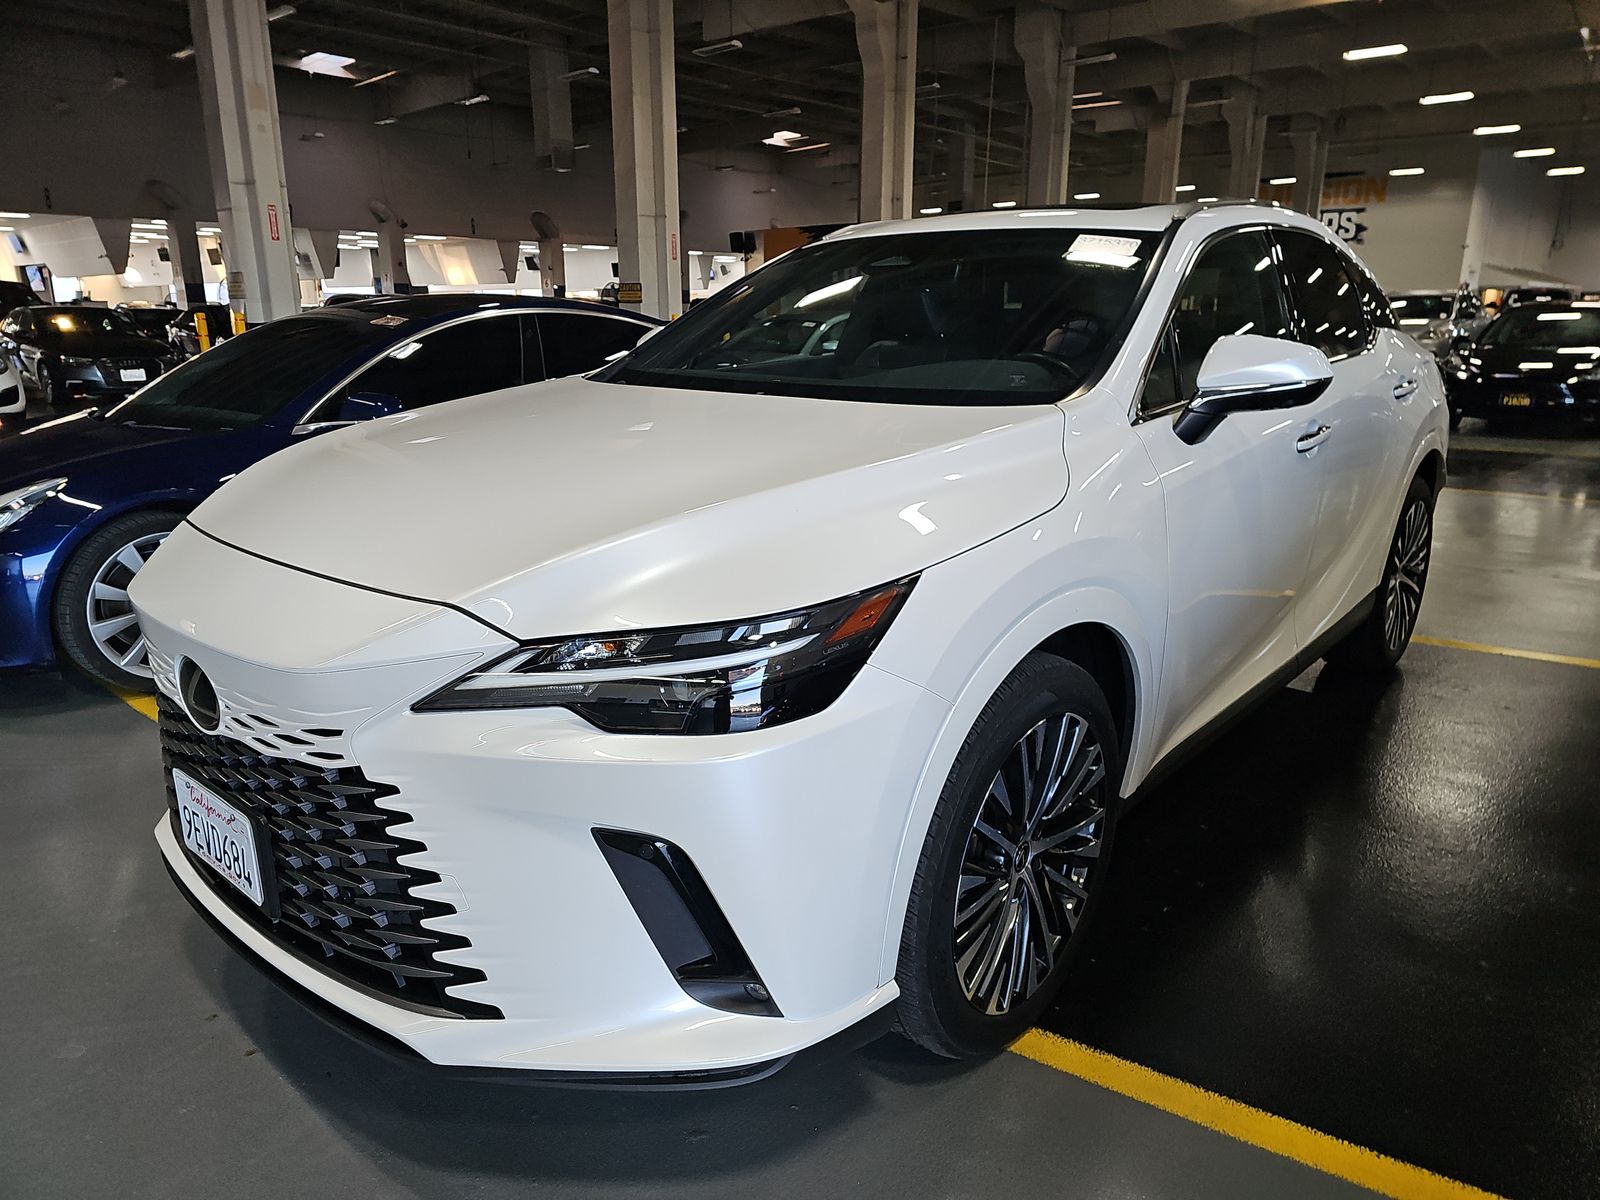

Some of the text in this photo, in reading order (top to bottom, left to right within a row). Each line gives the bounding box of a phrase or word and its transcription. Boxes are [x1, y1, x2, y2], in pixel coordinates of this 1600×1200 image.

[822, 641, 849, 655] LEXUS
[190, 785, 237, 833] California
[183, 804, 253, 889] 9EVD684
